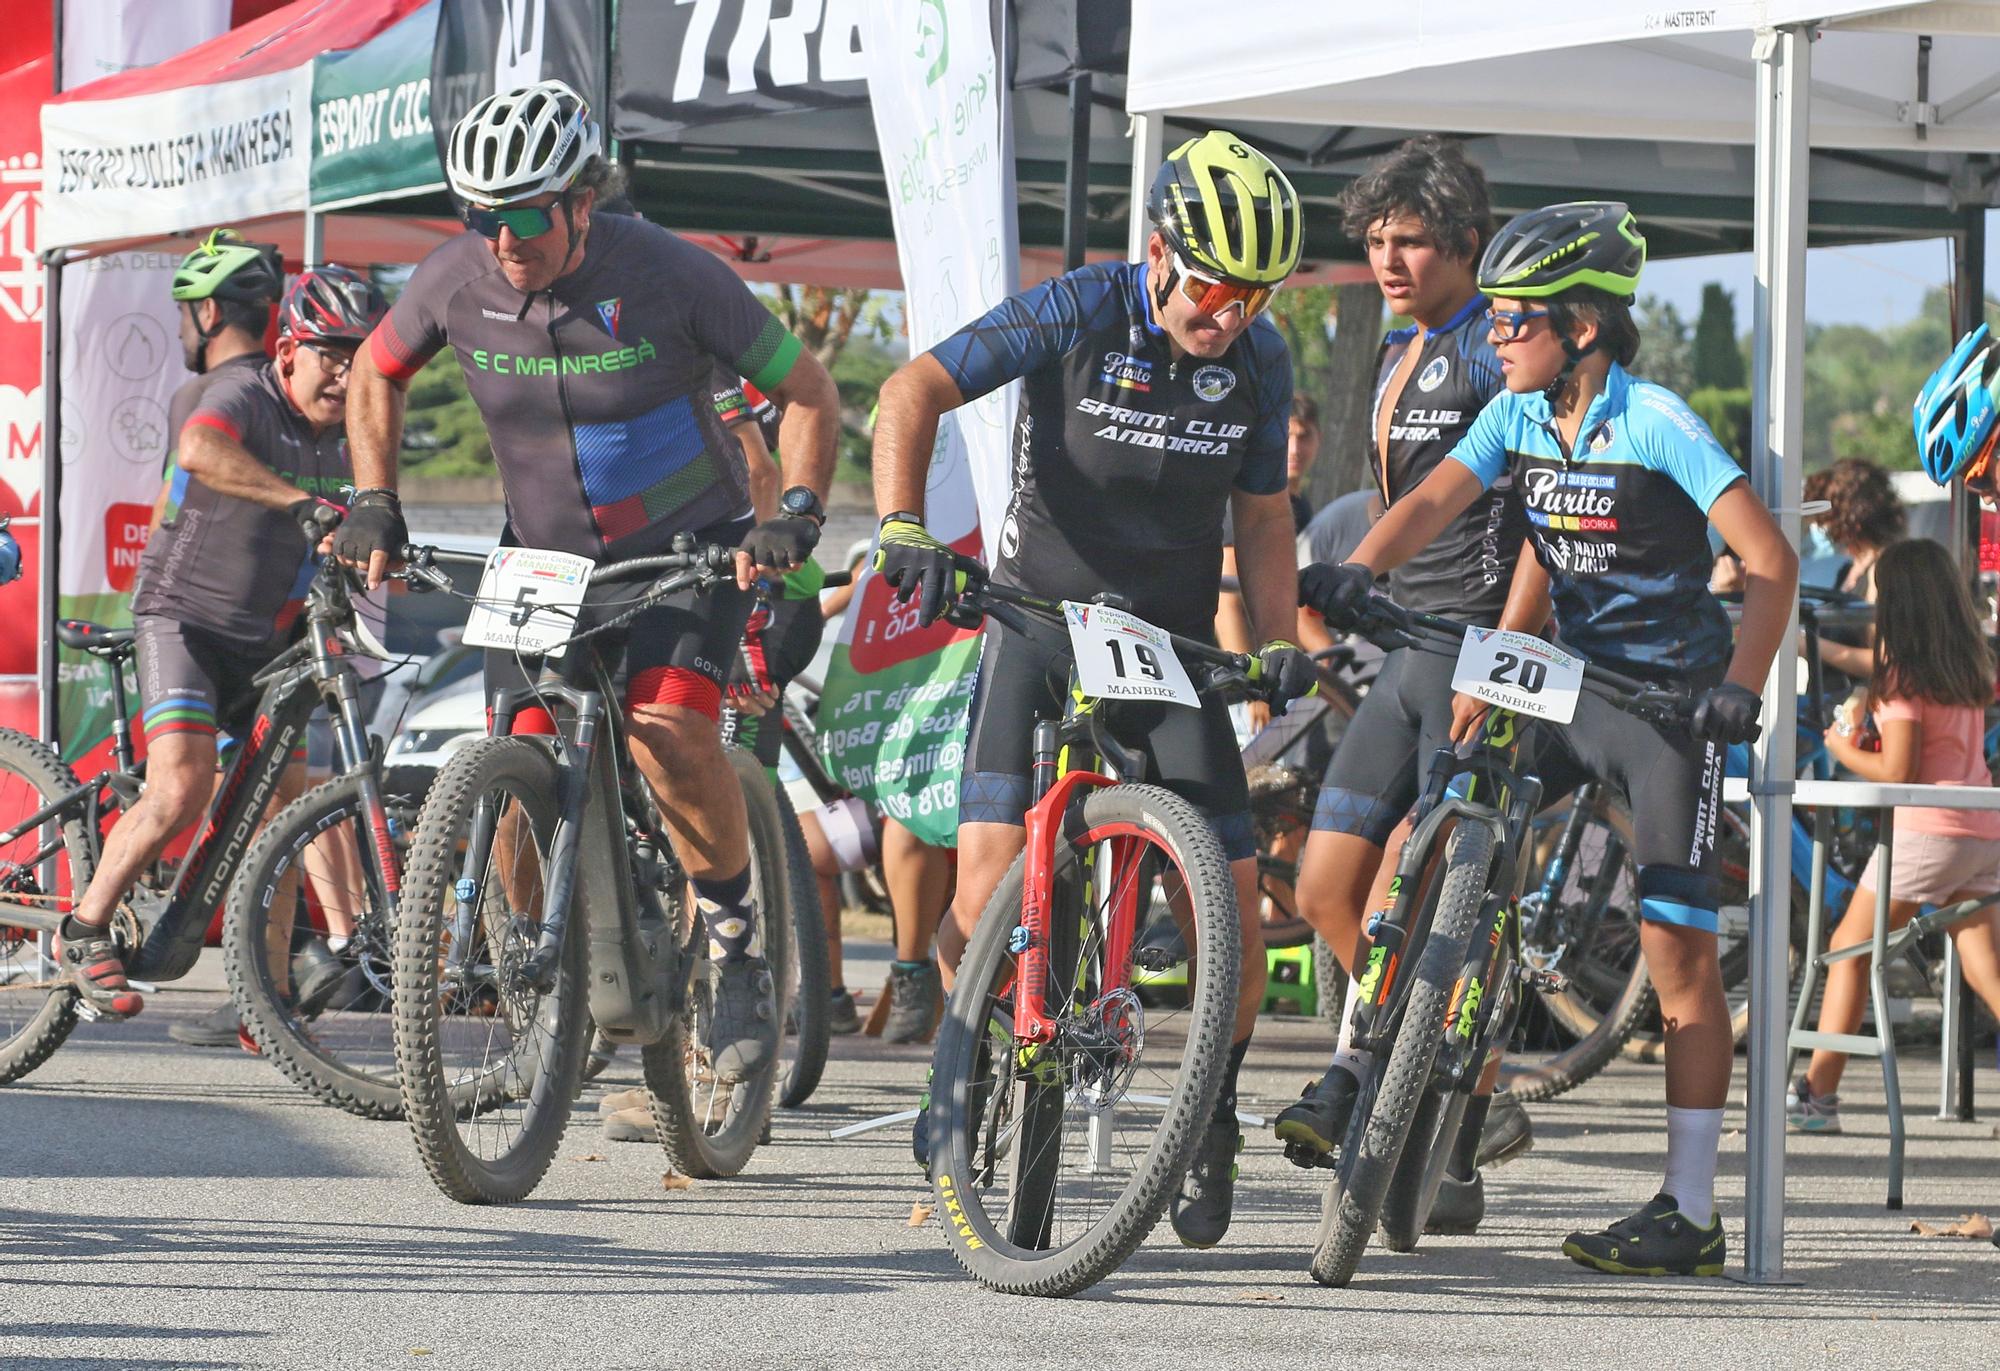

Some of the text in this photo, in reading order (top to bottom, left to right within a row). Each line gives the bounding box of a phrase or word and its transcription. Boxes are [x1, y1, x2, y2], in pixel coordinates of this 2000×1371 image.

[1664, 10, 1715, 28] MASTERTENT
[319, 87, 390, 157] ESPORT
[59, 148, 124, 193] ESPORT
[127, 133, 208, 189] CICLISTA
[1185, 420, 1247, 438] CLUB
[1406, 409, 1462, 424] CLUB
[1094, 425, 1229, 455] ANDORRA
[1525, 468, 1615, 516] Purito
[1573, 540, 1618, 558] NATUR
[1573, 555, 1609, 573] LAND
[509, 586, 538, 627] 5
[483, 632, 544, 649] MANBIKE
[694, 656, 724, 681] GORE
[1105, 638, 1164, 681] 19
[1489, 651, 1548, 694] 20
[1107, 684, 1177, 698] MANBIKE
[1476, 685, 1547, 714] MANBIKE
[204, 724, 296, 905] MONDRAKER
[1689, 740, 1715, 868] SPRINT CLUB
[1706, 755, 1722, 851] ANDORRA
[939, 1175, 984, 1251] MAXXIS
